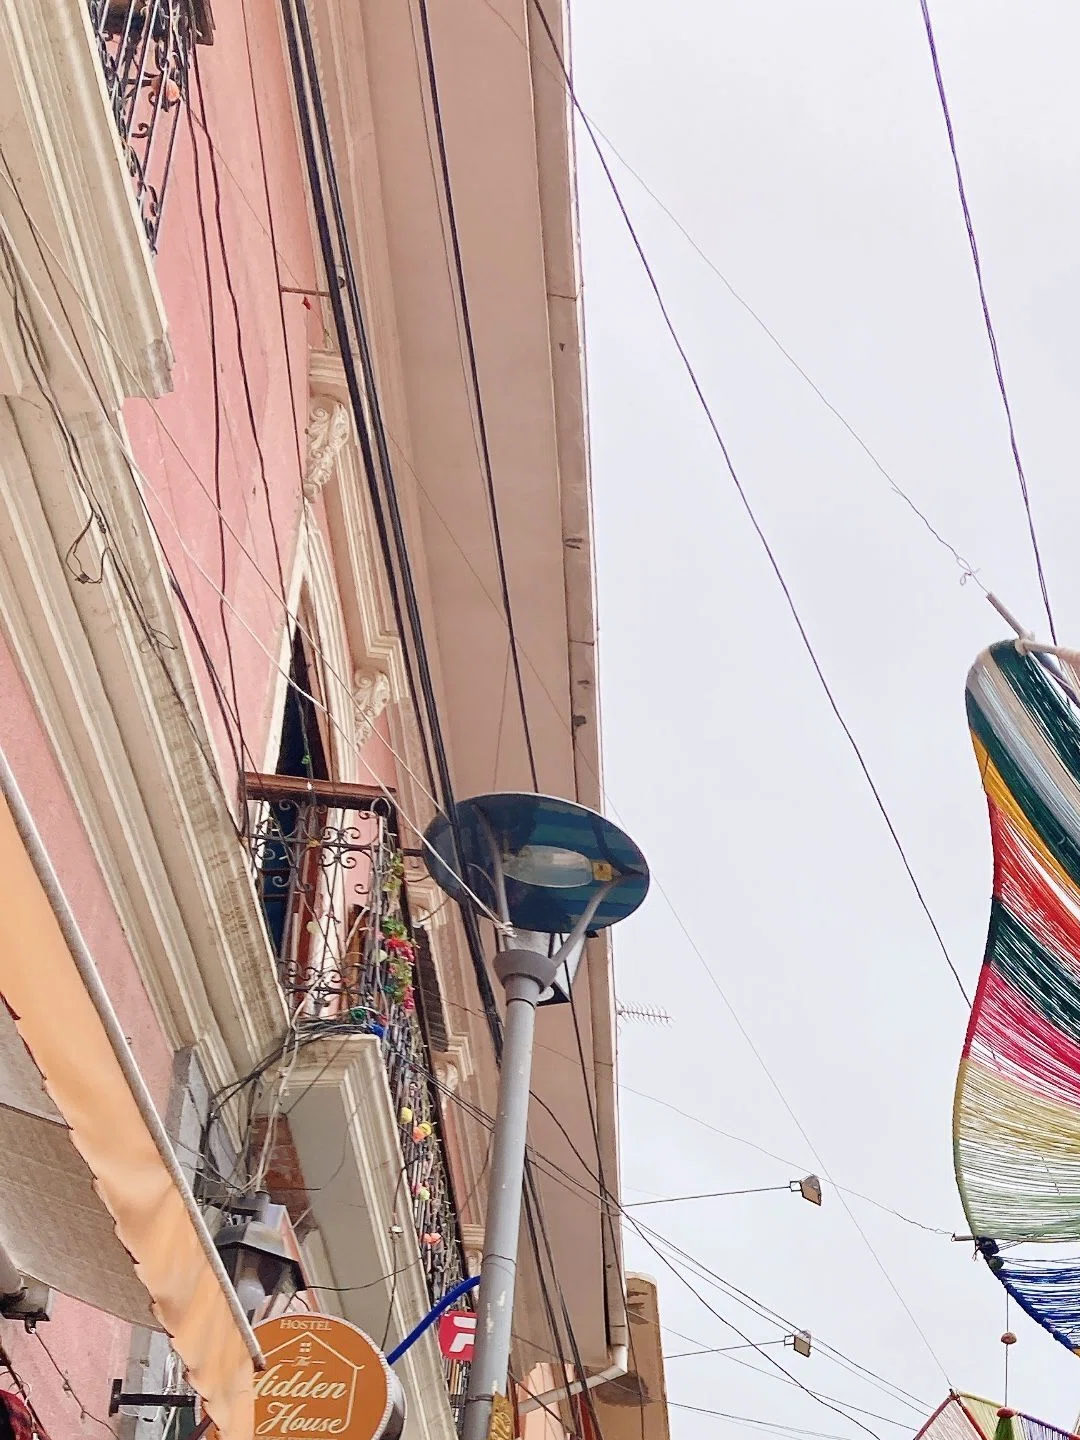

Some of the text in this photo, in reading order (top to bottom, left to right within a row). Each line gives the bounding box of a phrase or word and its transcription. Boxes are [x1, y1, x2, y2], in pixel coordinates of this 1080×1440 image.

[279, 1319, 332, 1331] HOSTEL
[251, 1364, 347, 1400] Hidden
[255, 1401, 346, 1435] House
